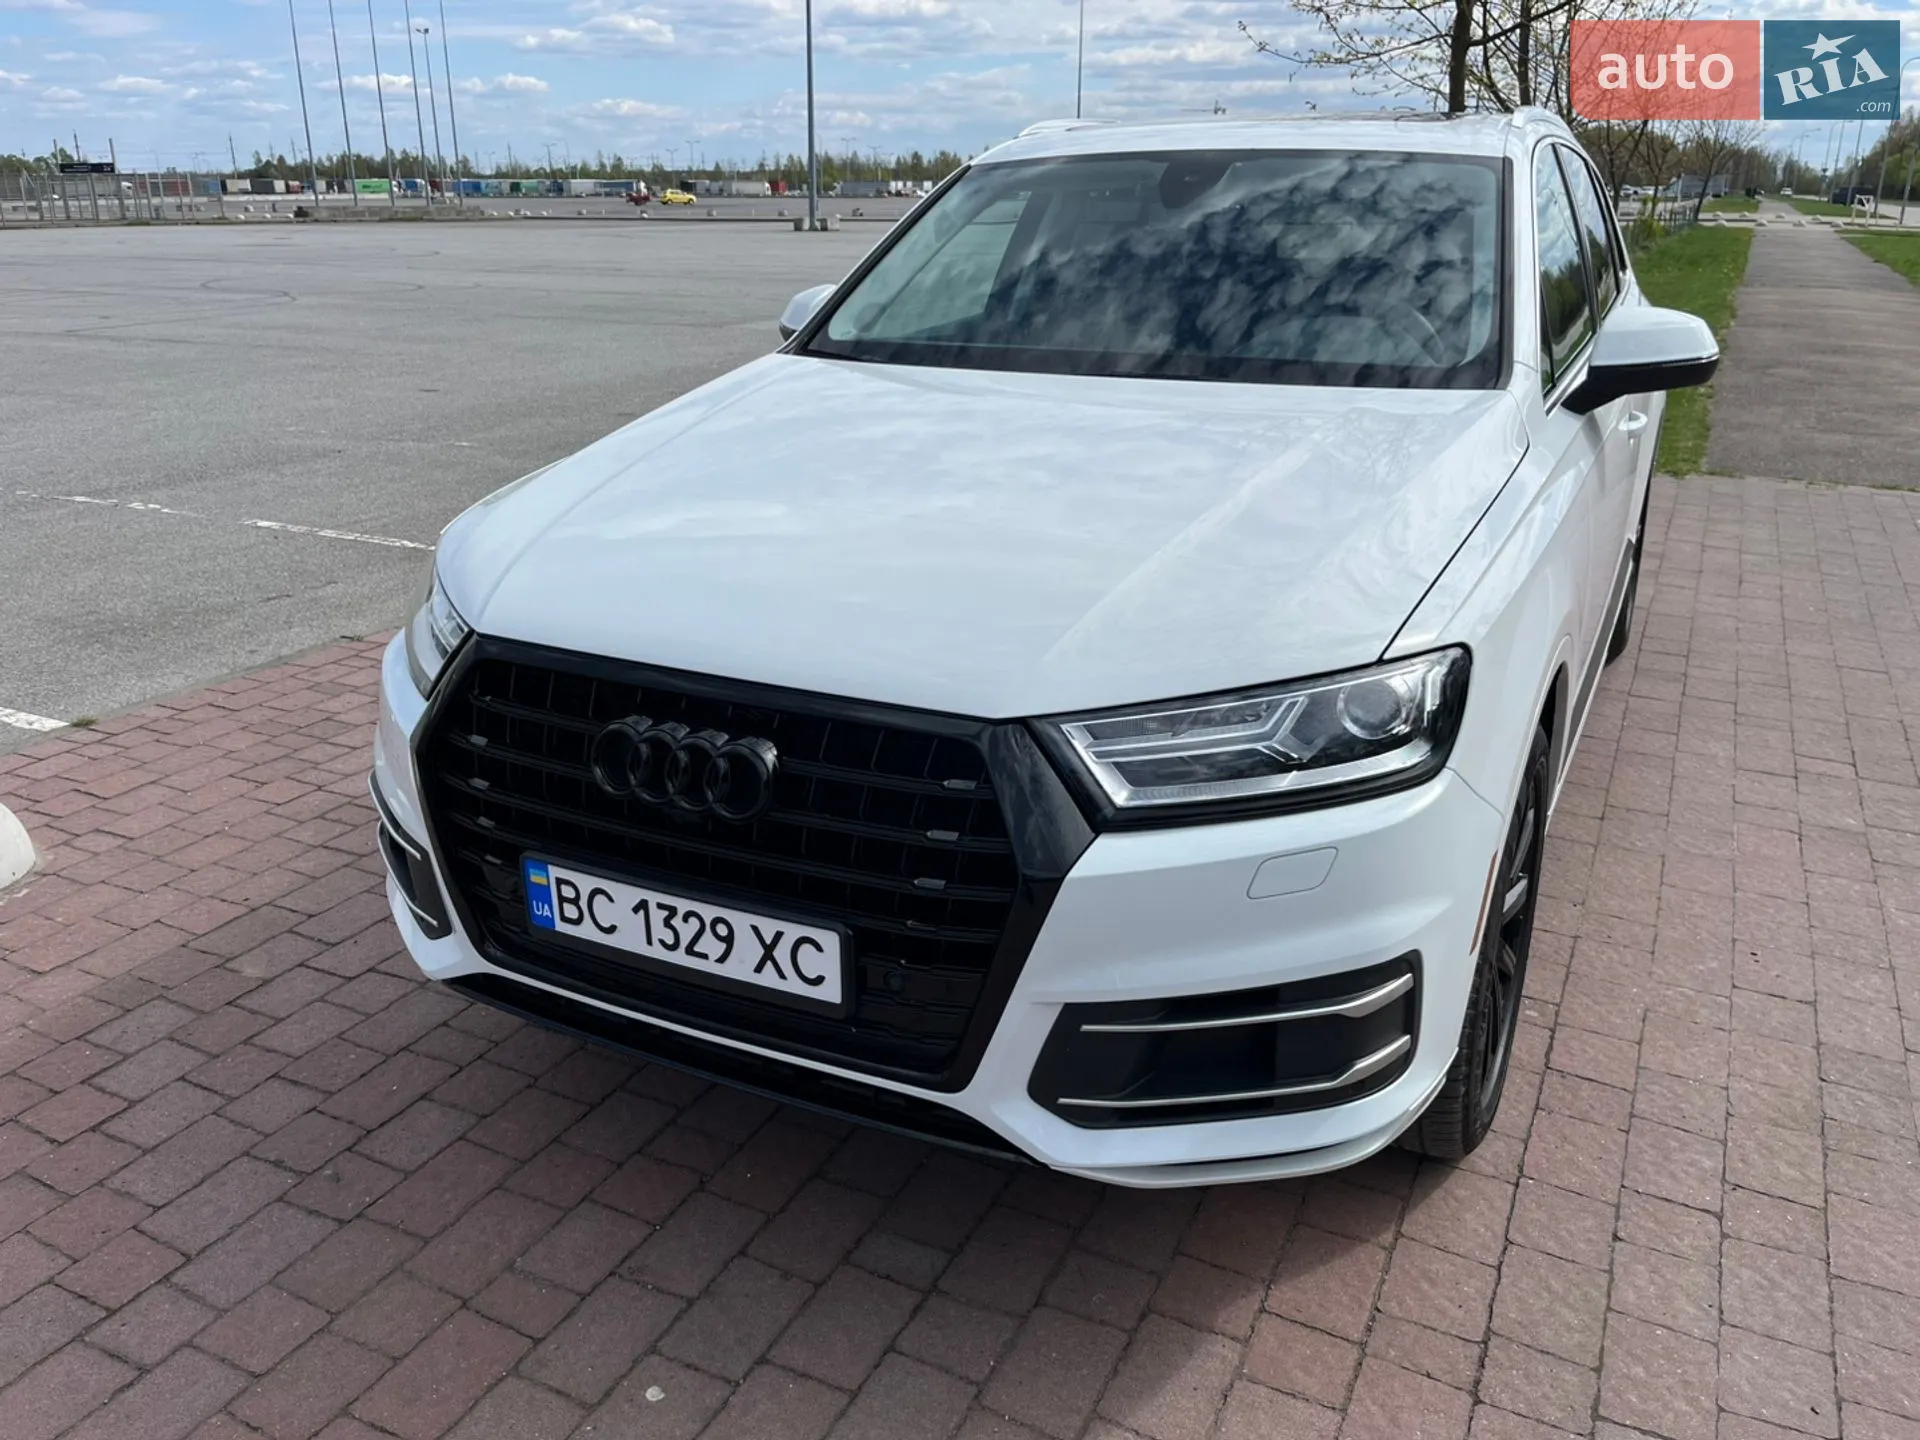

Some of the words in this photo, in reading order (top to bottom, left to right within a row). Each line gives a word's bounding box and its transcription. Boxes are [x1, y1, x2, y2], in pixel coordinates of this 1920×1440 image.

[532, 900, 552, 918] UA
[555, 876, 618, 935] BC
[631, 898, 735, 965] 1329
[750, 924, 826, 987] XC
